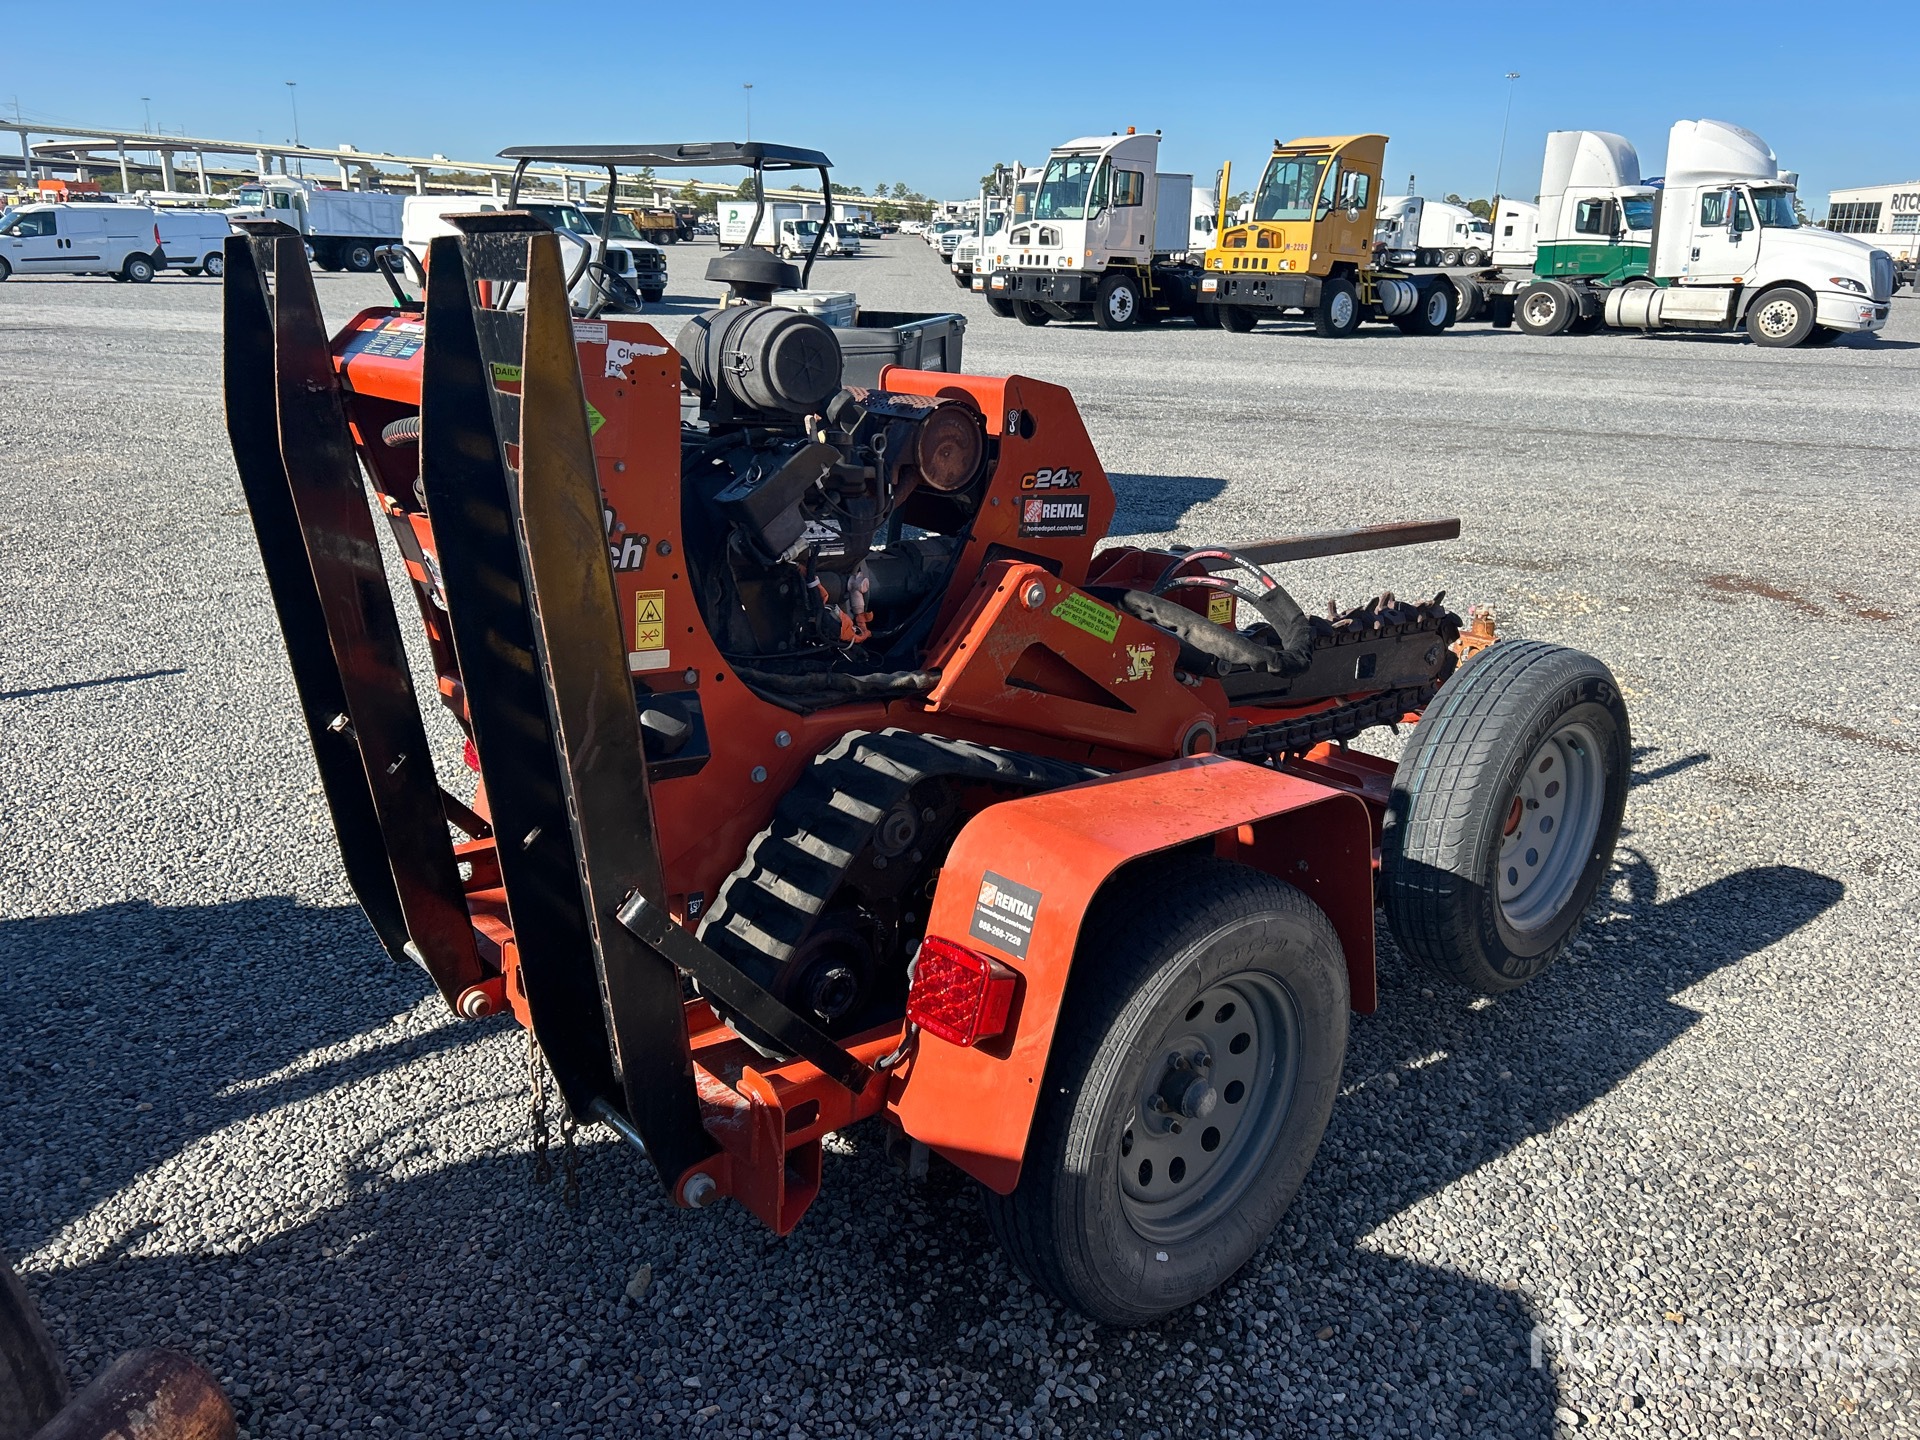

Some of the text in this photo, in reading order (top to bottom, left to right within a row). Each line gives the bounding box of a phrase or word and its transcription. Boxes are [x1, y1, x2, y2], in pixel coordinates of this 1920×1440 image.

[495, 367, 520, 377] DAILY
[1042, 503, 1084, 519] RENTAL
[1027, 525, 1084, 533] homedepot.com/rental
[1075, 598, 1097, 615] CLEANING
[1096, 609, 1106, 618] FEE
[1105, 613, 1116, 623] WILL
[1087, 613, 1098, 621] THIS
[1097, 617, 1117, 632] MACHINE
[1094, 624, 1110, 636] CLEAN
[1506, 681, 1618, 790] RADIAL ST
[994, 891, 1034, 921] RENTAL
